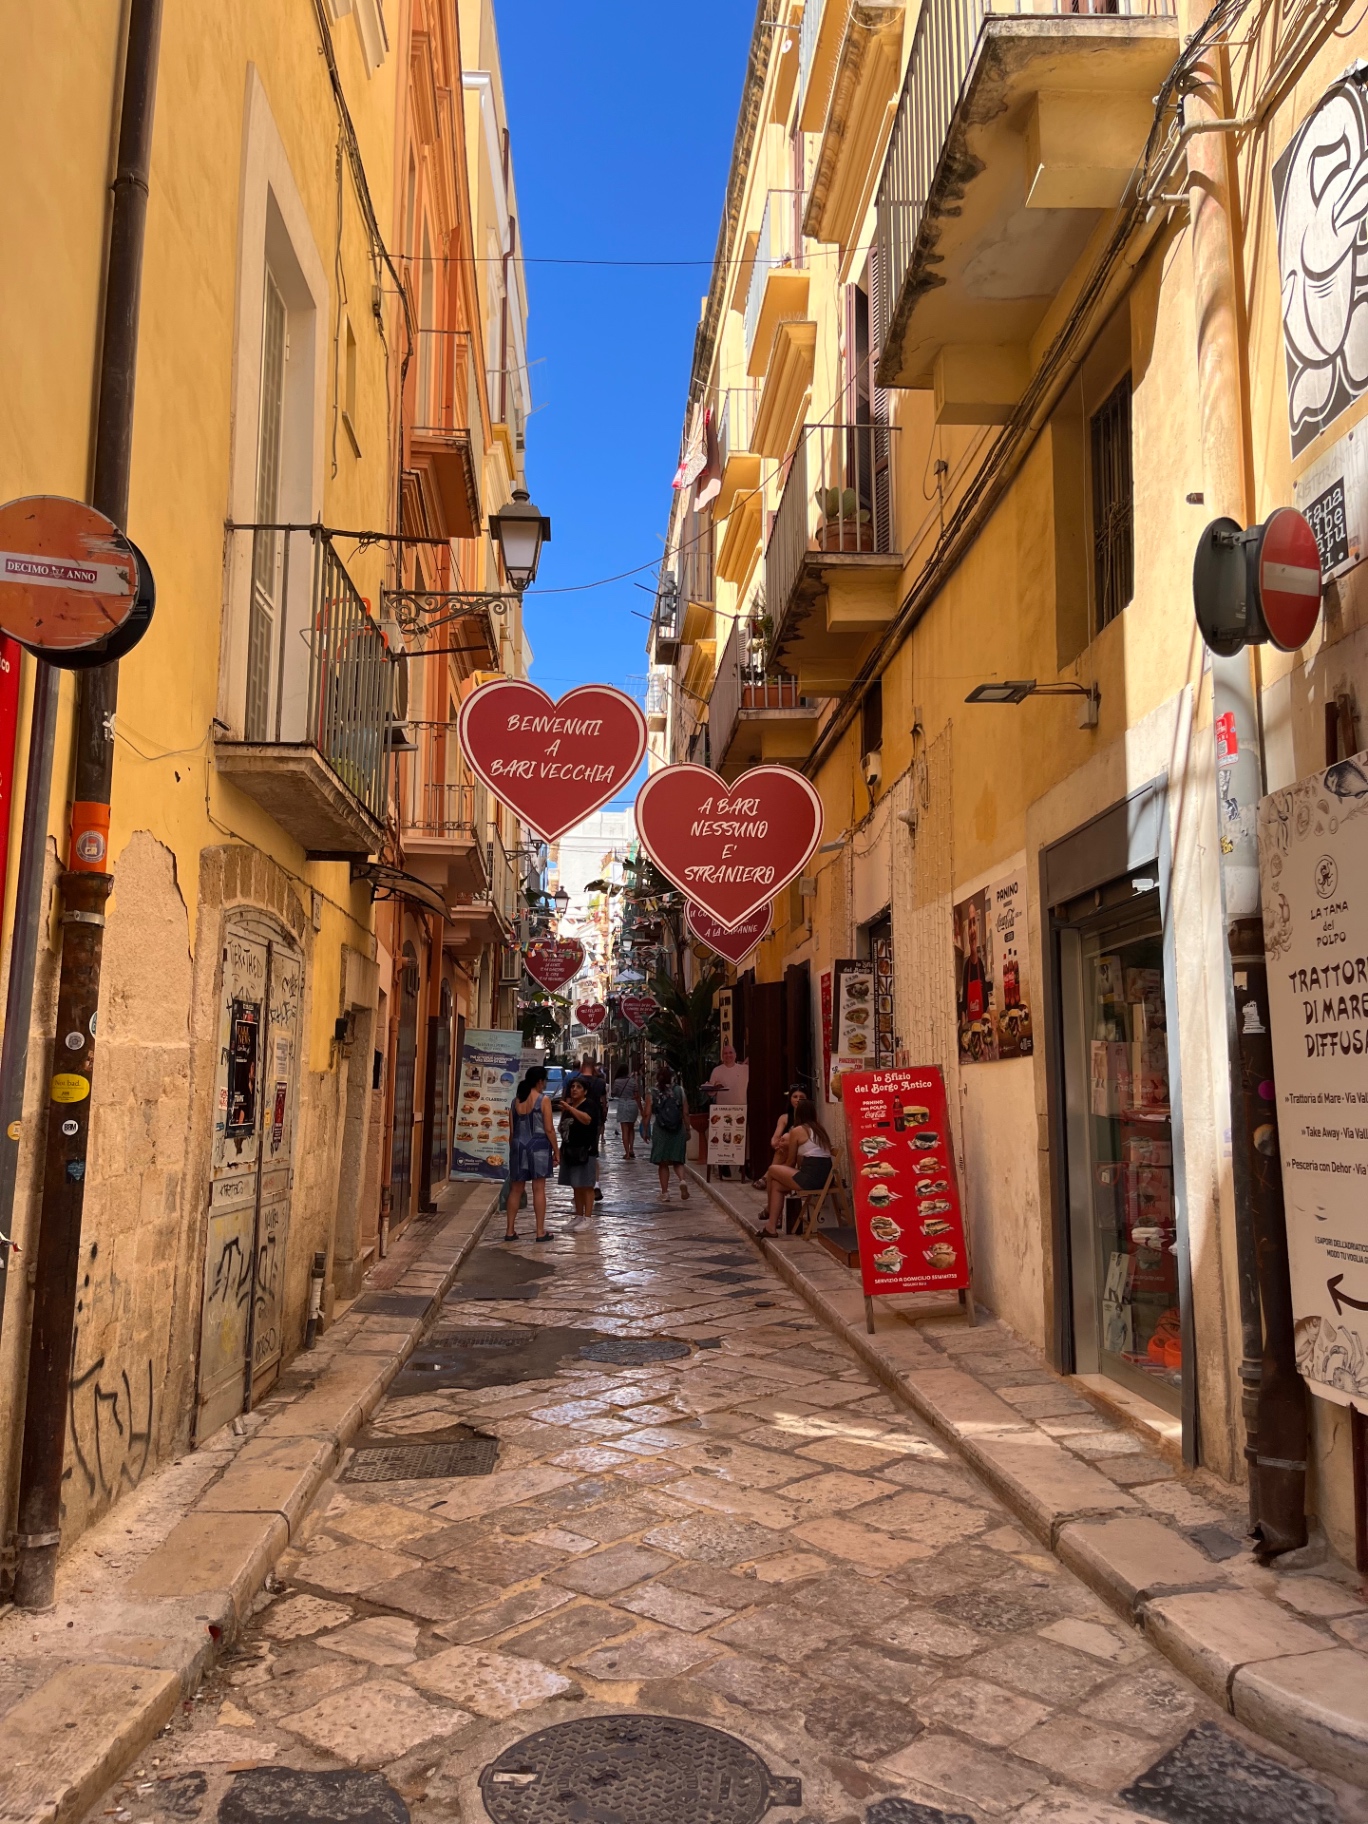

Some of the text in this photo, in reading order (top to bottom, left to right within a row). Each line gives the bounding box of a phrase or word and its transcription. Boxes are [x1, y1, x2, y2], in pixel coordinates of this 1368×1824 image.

[1305, 487, 1343, 526] tana
[7, 561, 97, 582] DECIMO ANNO
[507, 714, 603, 737] BENVENUTI
[544, 739, 560, 757] A
[490, 759, 615, 783] BARI VECCHIA
[698, 797, 761, 816] A BARI
[690, 819, 768, 839] NESSUNO
[721, 844, 737, 860] E'
[684, 864, 775, 885] STRANIERO
[996, 882, 1018, 902] PANINO
[1310, 901, 1349, 920] LA TANA
[705, 928, 711, 938] A
[712, 928, 721, 937] LA
[1323, 920, 1335, 931] del
[1317, 931, 1346, 947] POLPO
[1289, 957, 1368, 994] TRATTOR
[1303, 993, 1368, 1025] DI MARE
[855, 1080, 932, 1093] del Borgo Antico
[874, 1072, 911, 1083] lo Sfizio
[1289, 1092, 1316, 1104] Trattoria
[1317, 1092, 1323, 1104] di
[1324, 1092, 1341, 1104] Mare
[1344, 1092, 1356, 1103] Via
[1306, 1126, 1321, 1137] Take
[1322, 1127, 1340, 1140] Away
[1343, 1127, 1354, 1139] Via
[1291, 1158, 1367, 1175] Pesceria con Dehor Via
[1317, 1236, 1333, 1246] SAPORI
[1326, 1249, 1340, 1258] MODO
[1340, 1251, 1346, 1260] TU
[1347, 1253, 1364, 1263] VOGLIA
